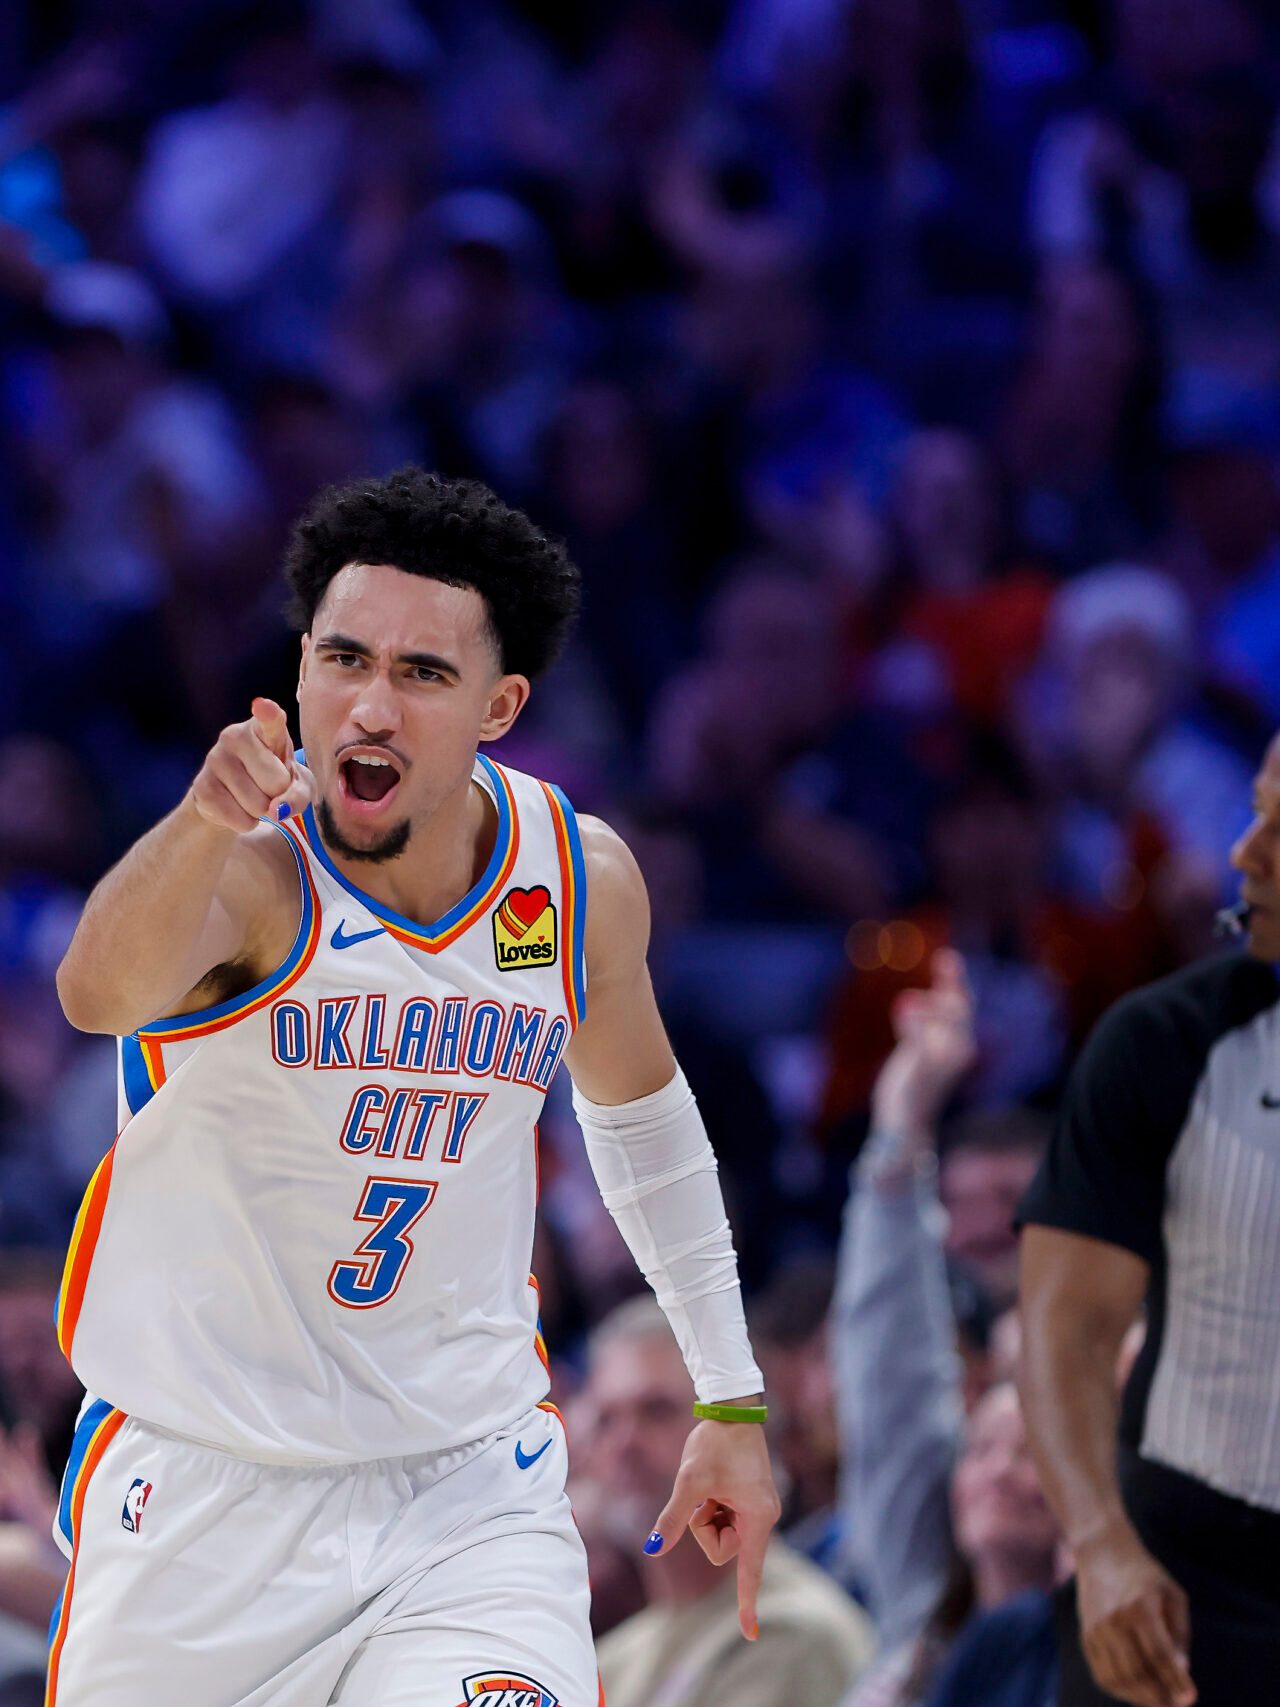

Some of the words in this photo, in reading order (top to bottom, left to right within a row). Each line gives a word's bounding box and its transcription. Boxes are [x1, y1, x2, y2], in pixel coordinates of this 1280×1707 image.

[270, 993, 568, 1094] OKLAHOMA
[339, 1084, 490, 1163] CITY
[326, 1175, 439, 1310] 3
